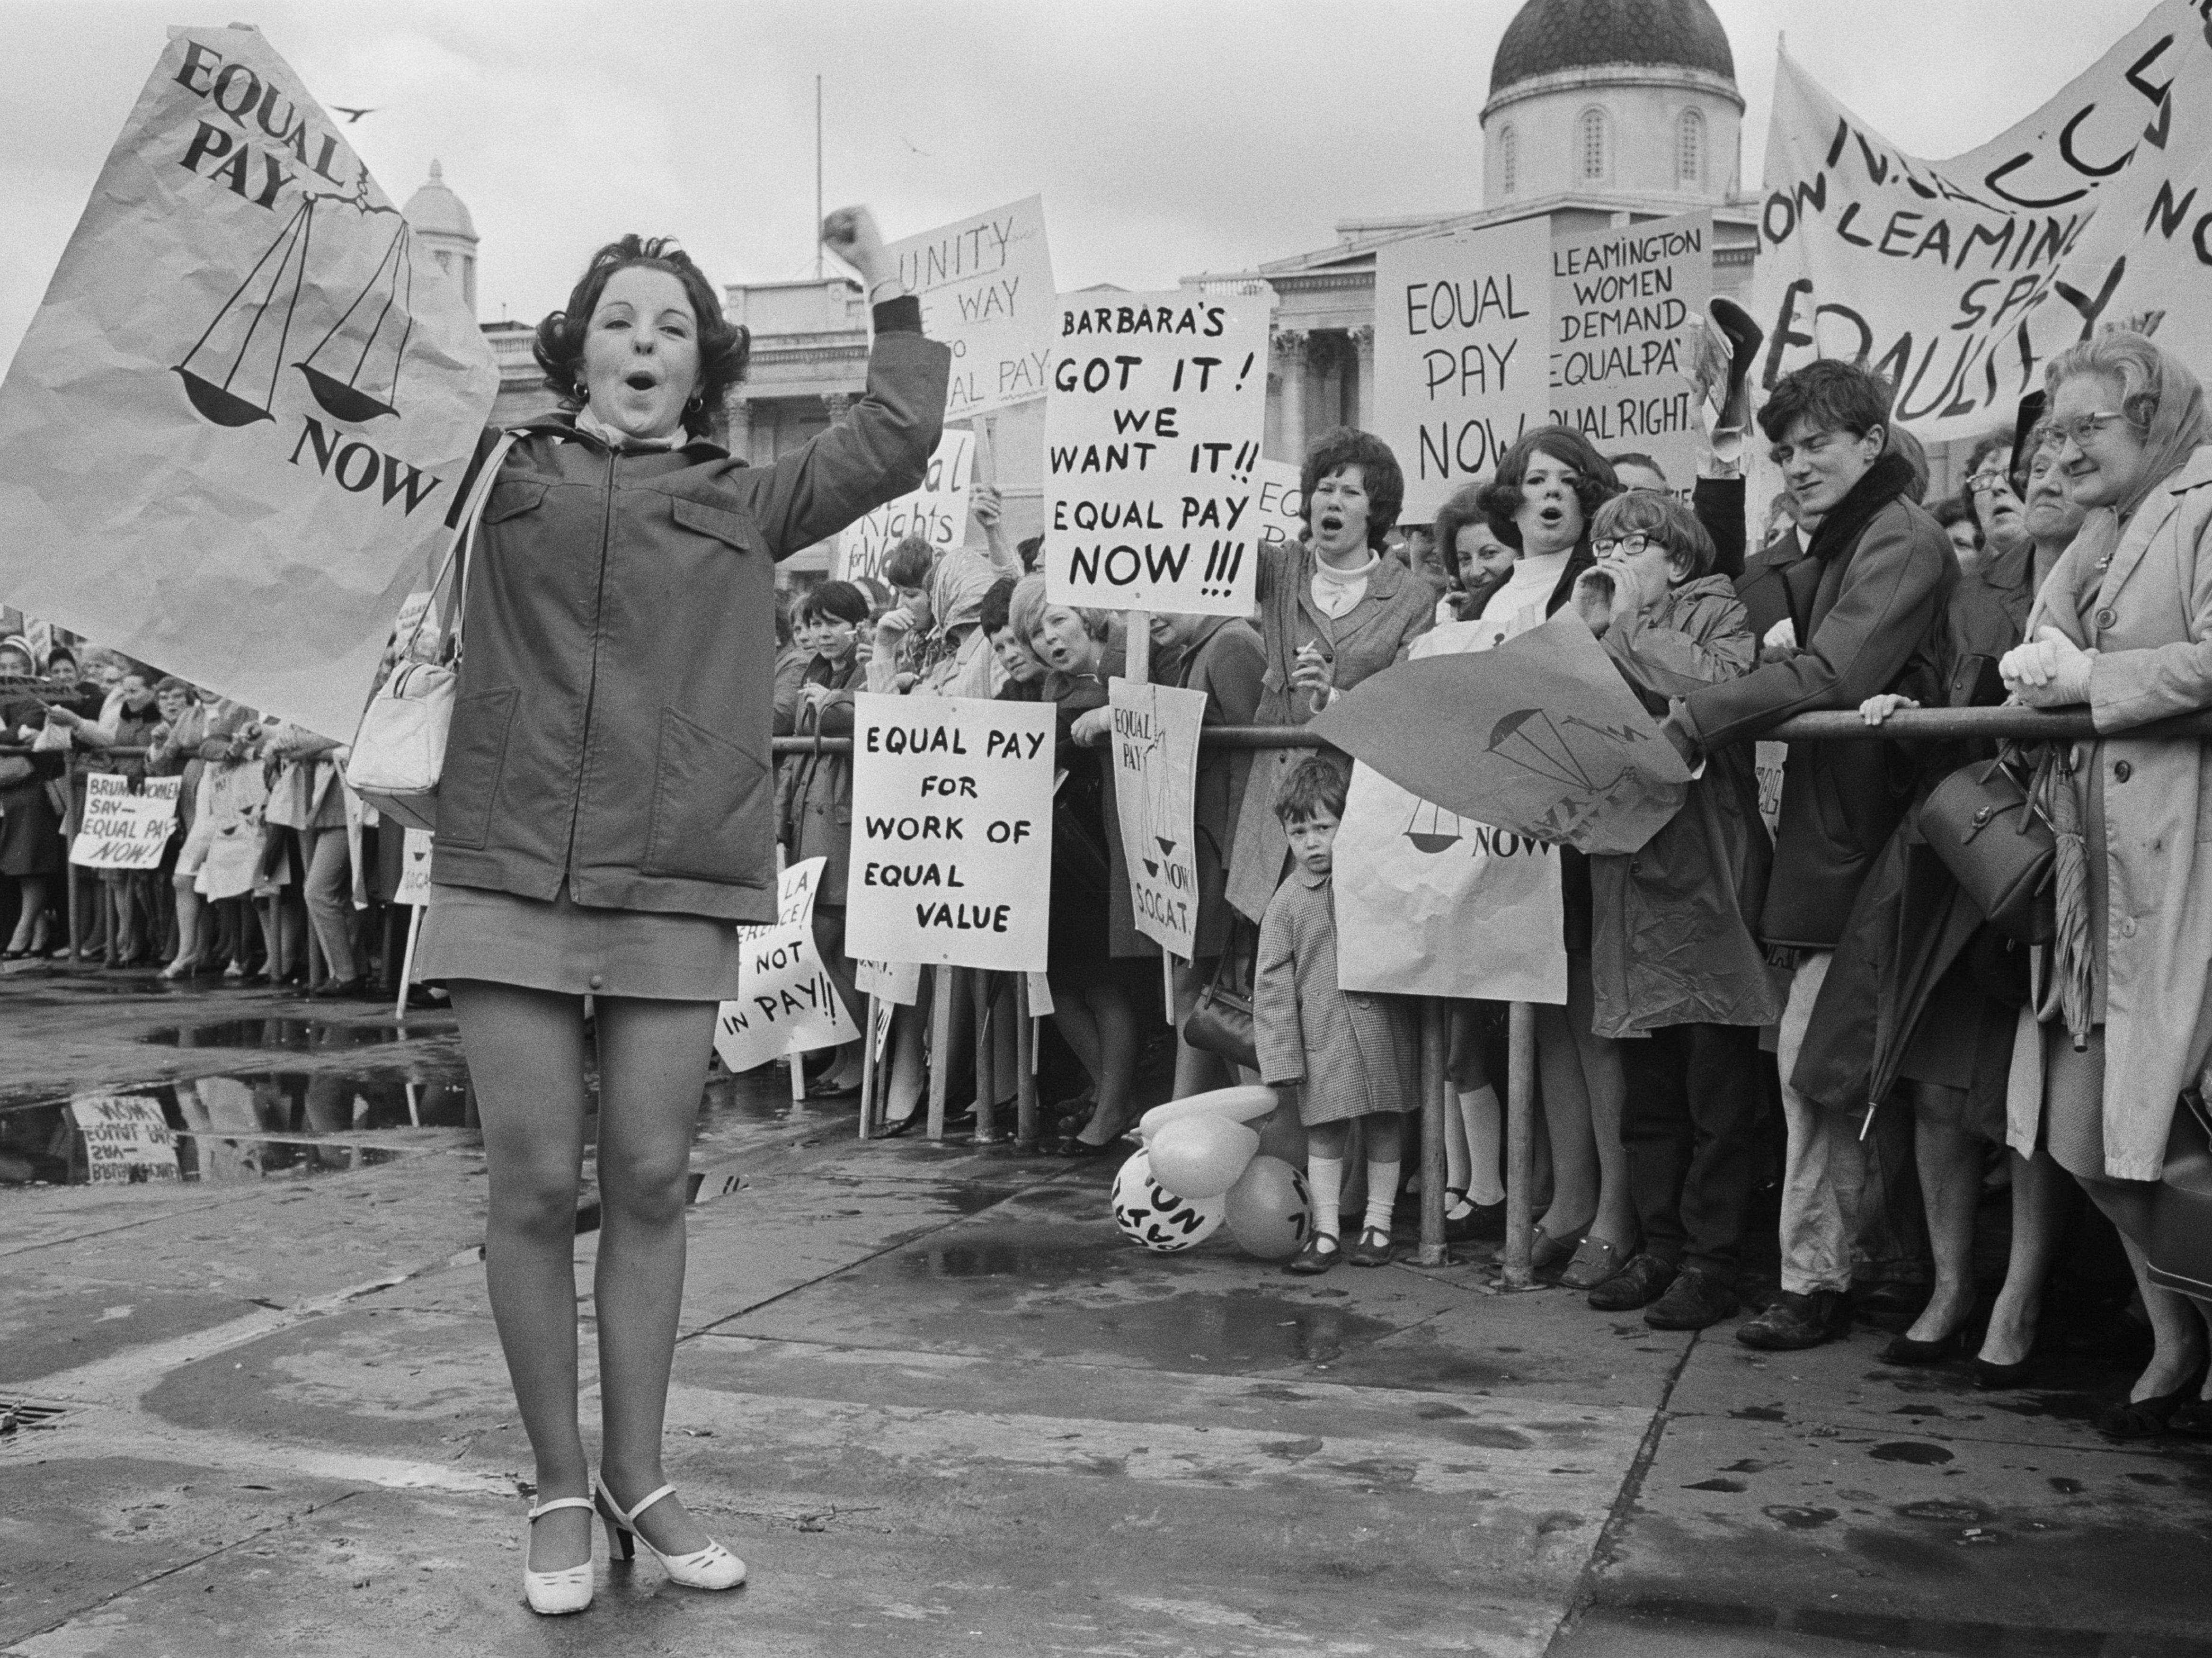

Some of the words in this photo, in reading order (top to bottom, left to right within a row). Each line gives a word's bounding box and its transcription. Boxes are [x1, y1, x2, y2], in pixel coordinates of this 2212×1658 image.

[172, 39, 345, 188] EQUAL
[178, 119, 298, 212] PAY
[1837, 202, 2097, 271] LEAMIN
[899, 215, 1013, 294] UNITY
[958, 276, 1019, 321] WAY
[1574, 265, 1672, 306] WOMEN
[1062, 302, 1226, 337] BARBARA'S
[1407, 274, 1530, 335] EQUAL
[1560, 298, 1687, 343] DEMAND
[999, 348, 1051, 393] PAY
[1055, 355, 1143, 393] GOT
[1423, 339, 1517, 401] PAY
[1114, 407, 1179, 438] WE
[1617, 392, 1694, 437] RIGHT
[287, 414, 443, 517] NOW
[1050, 442, 1157, 474] WANT
[1054, 500, 1164, 531] EQUAL
[1182, 496, 1249, 531] PAY
[1114, 708, 1152, 740] EQUAL
[867, 726, 967, 755] EQUAL
[987, 730, 1045, 759] PAY
[1123, 742, 1143, 771] PAY
[921, 775, 978, 799] FOR
[83, 818, 136, 839] EQUAL
[866, 816, 964, 840] WORK
[986, 820, 1031, 844] OF
[864, 863, 965, 887] EQUAL
[916, 902, 1011, 933] VALUE
[756, 940, 803, 974] NOT
[722, 1011, 749, 1035] IN
